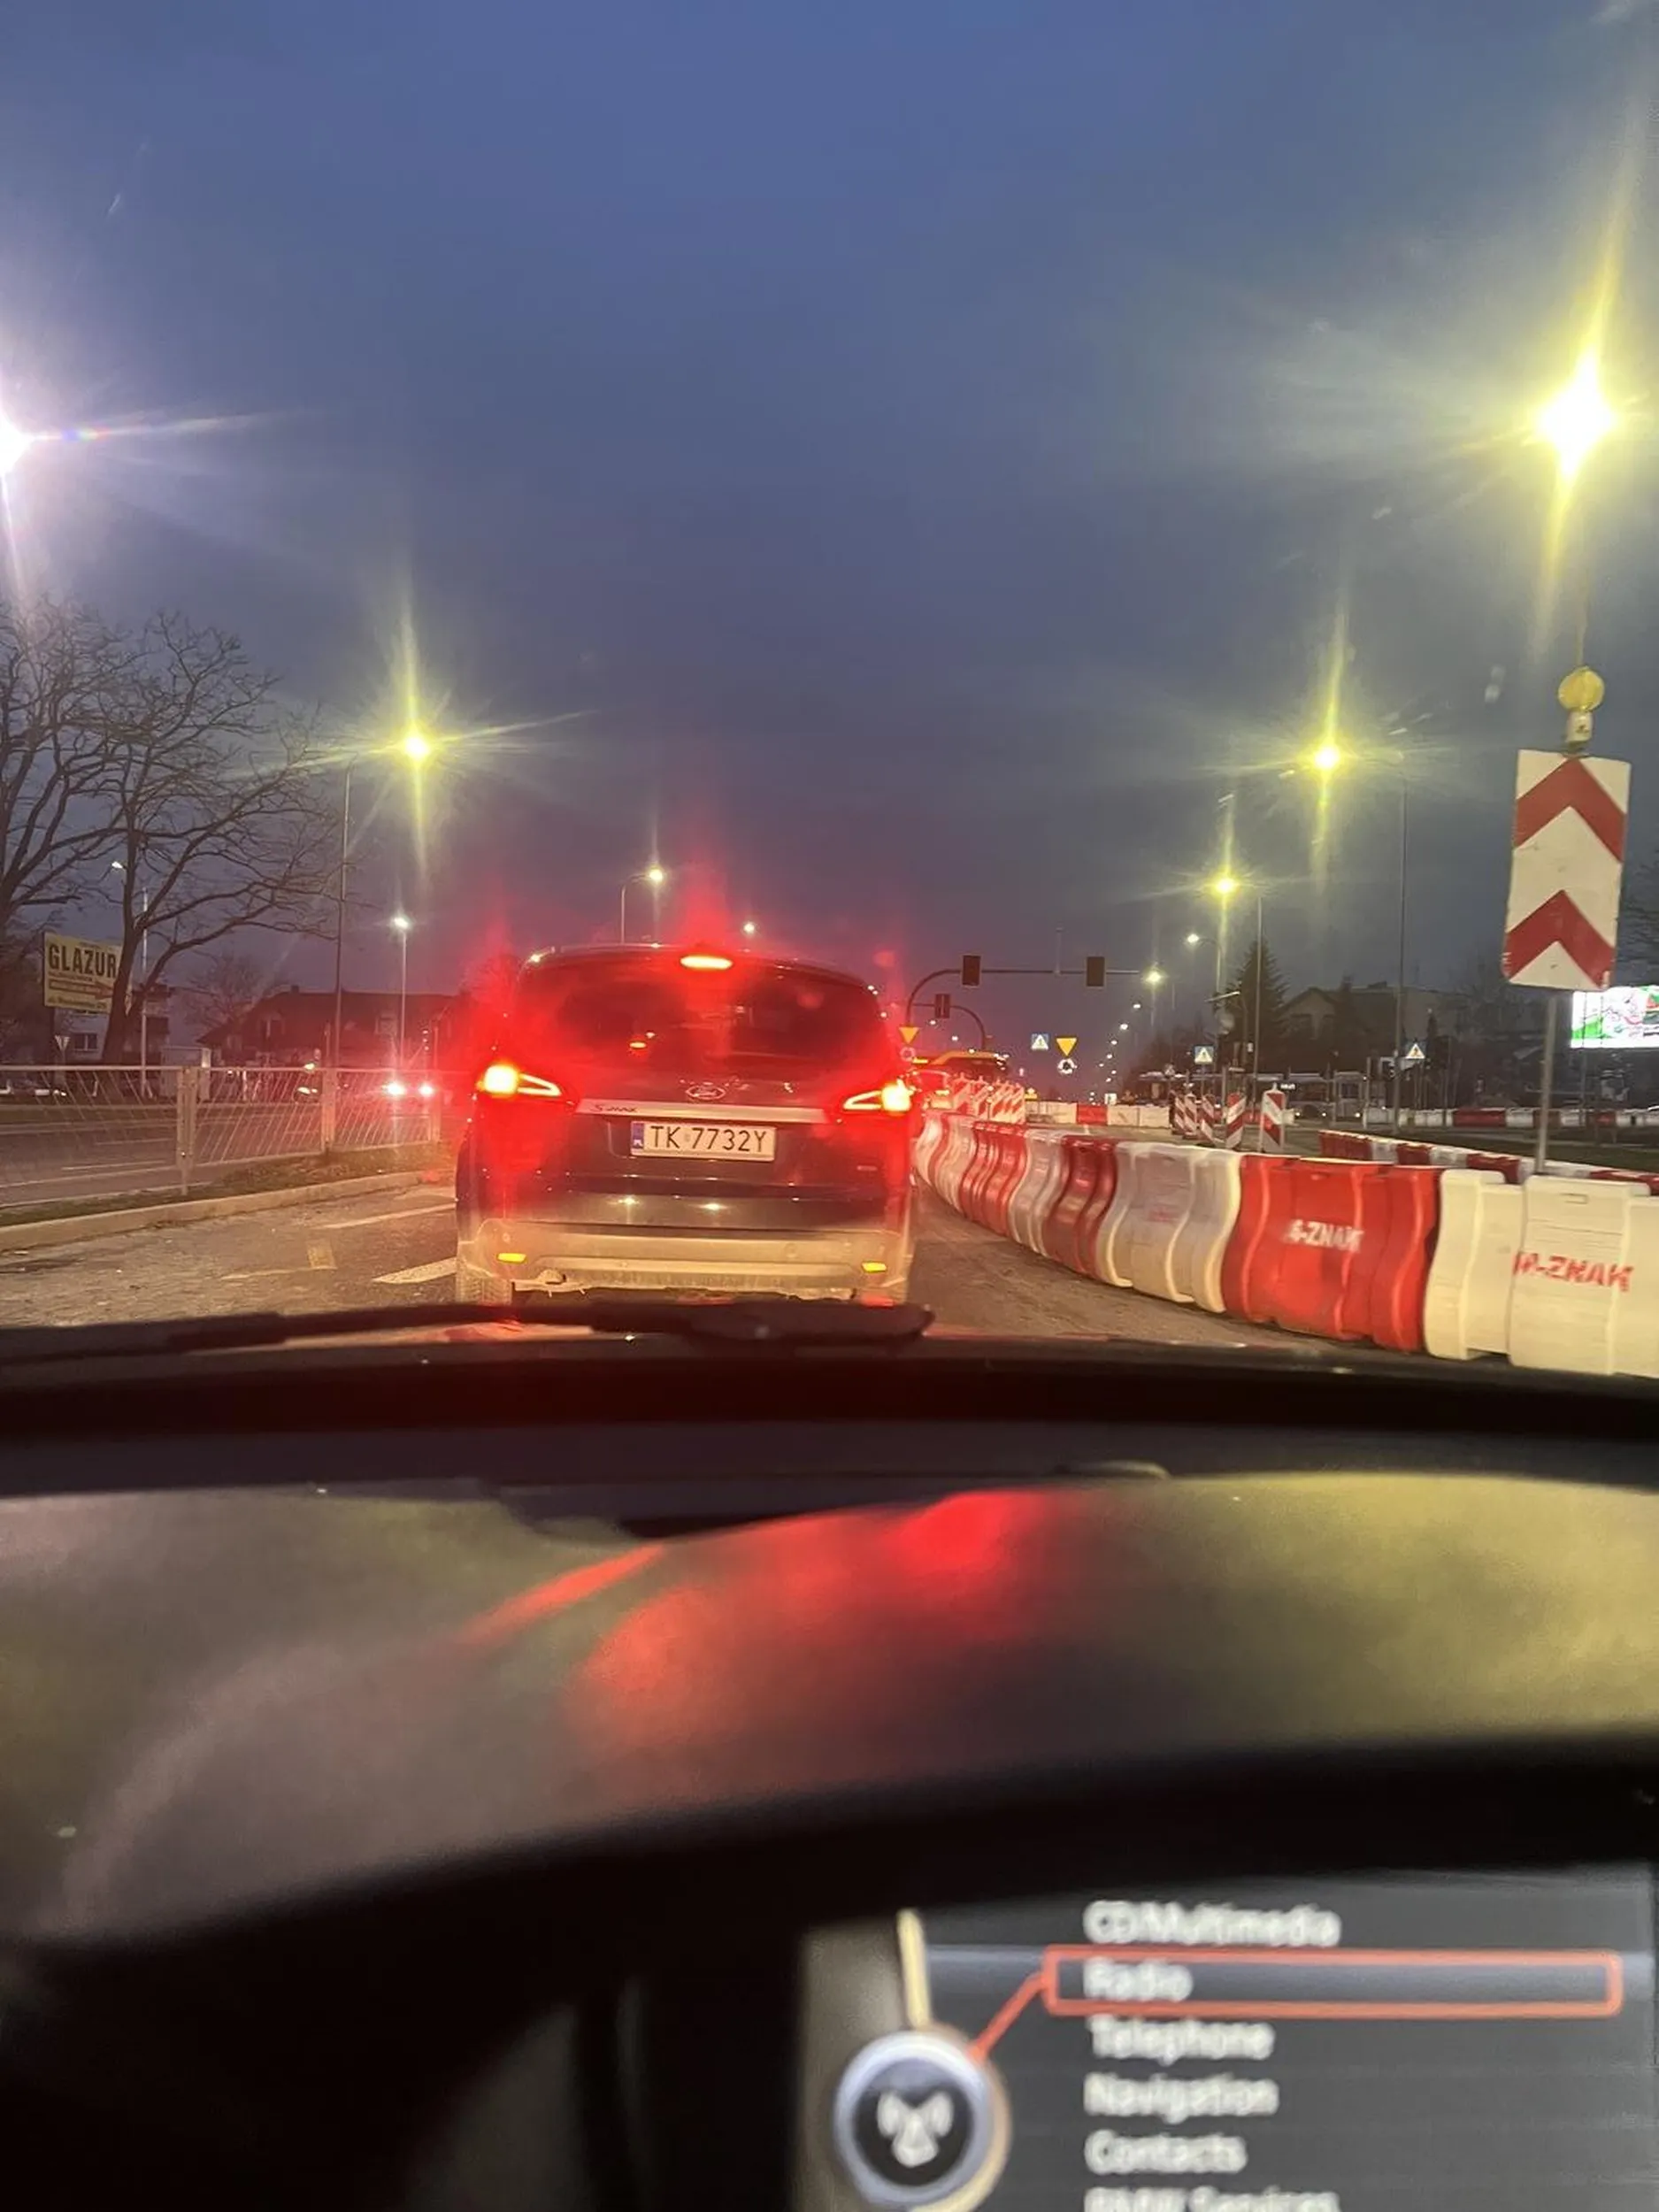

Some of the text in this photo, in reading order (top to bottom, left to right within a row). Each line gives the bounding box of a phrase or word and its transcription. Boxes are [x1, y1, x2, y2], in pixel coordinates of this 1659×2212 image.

[649, 1125, 767, 1152] TK 7732Y
[1088, 2013, 1274, 2063] Telephone
[1084, 2073, 1279, 2123] Navigation
[1085, 2129, 1247, 2174] Contacts
